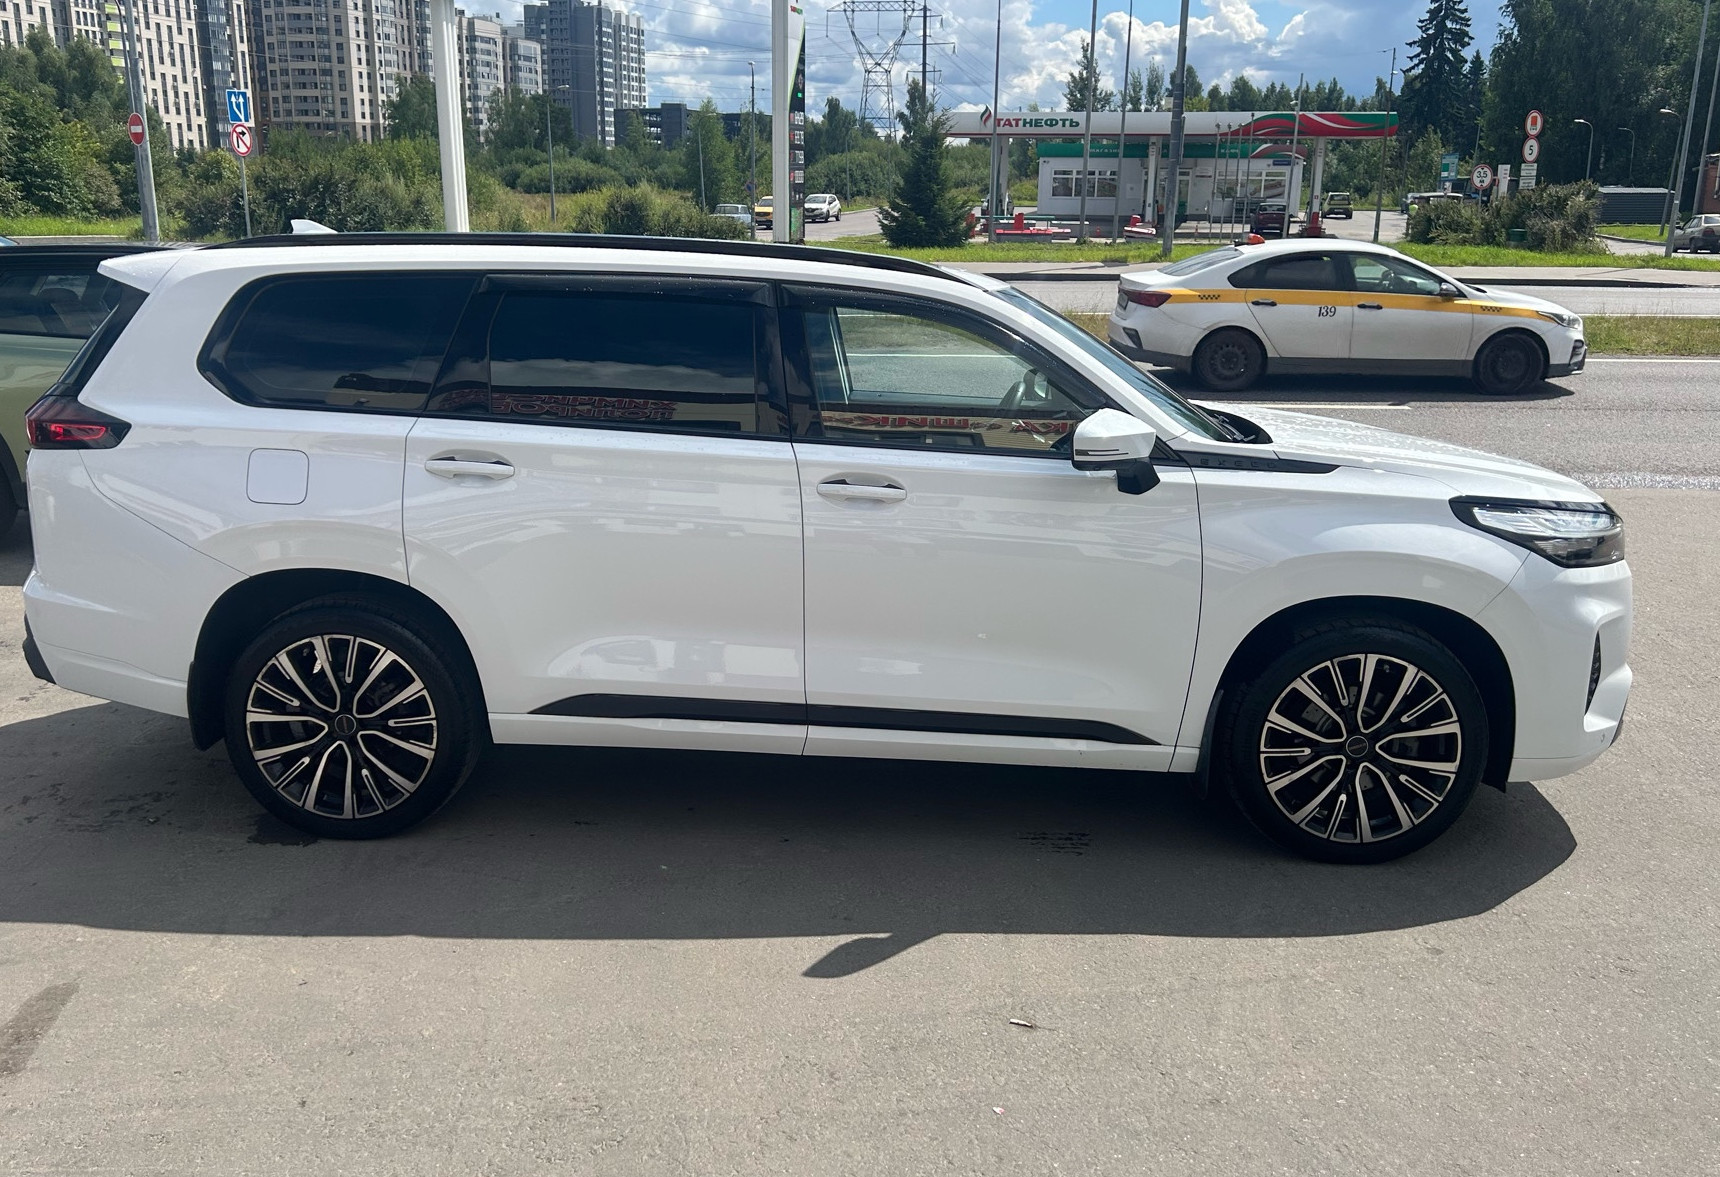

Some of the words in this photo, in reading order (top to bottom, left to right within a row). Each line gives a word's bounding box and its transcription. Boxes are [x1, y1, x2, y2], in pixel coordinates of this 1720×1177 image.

[996, 117, 1080, 128] ТАТНЕФТЬ
[1528, 144, 1534, 156] 5
[1318, 305, 1337, 317] 139
